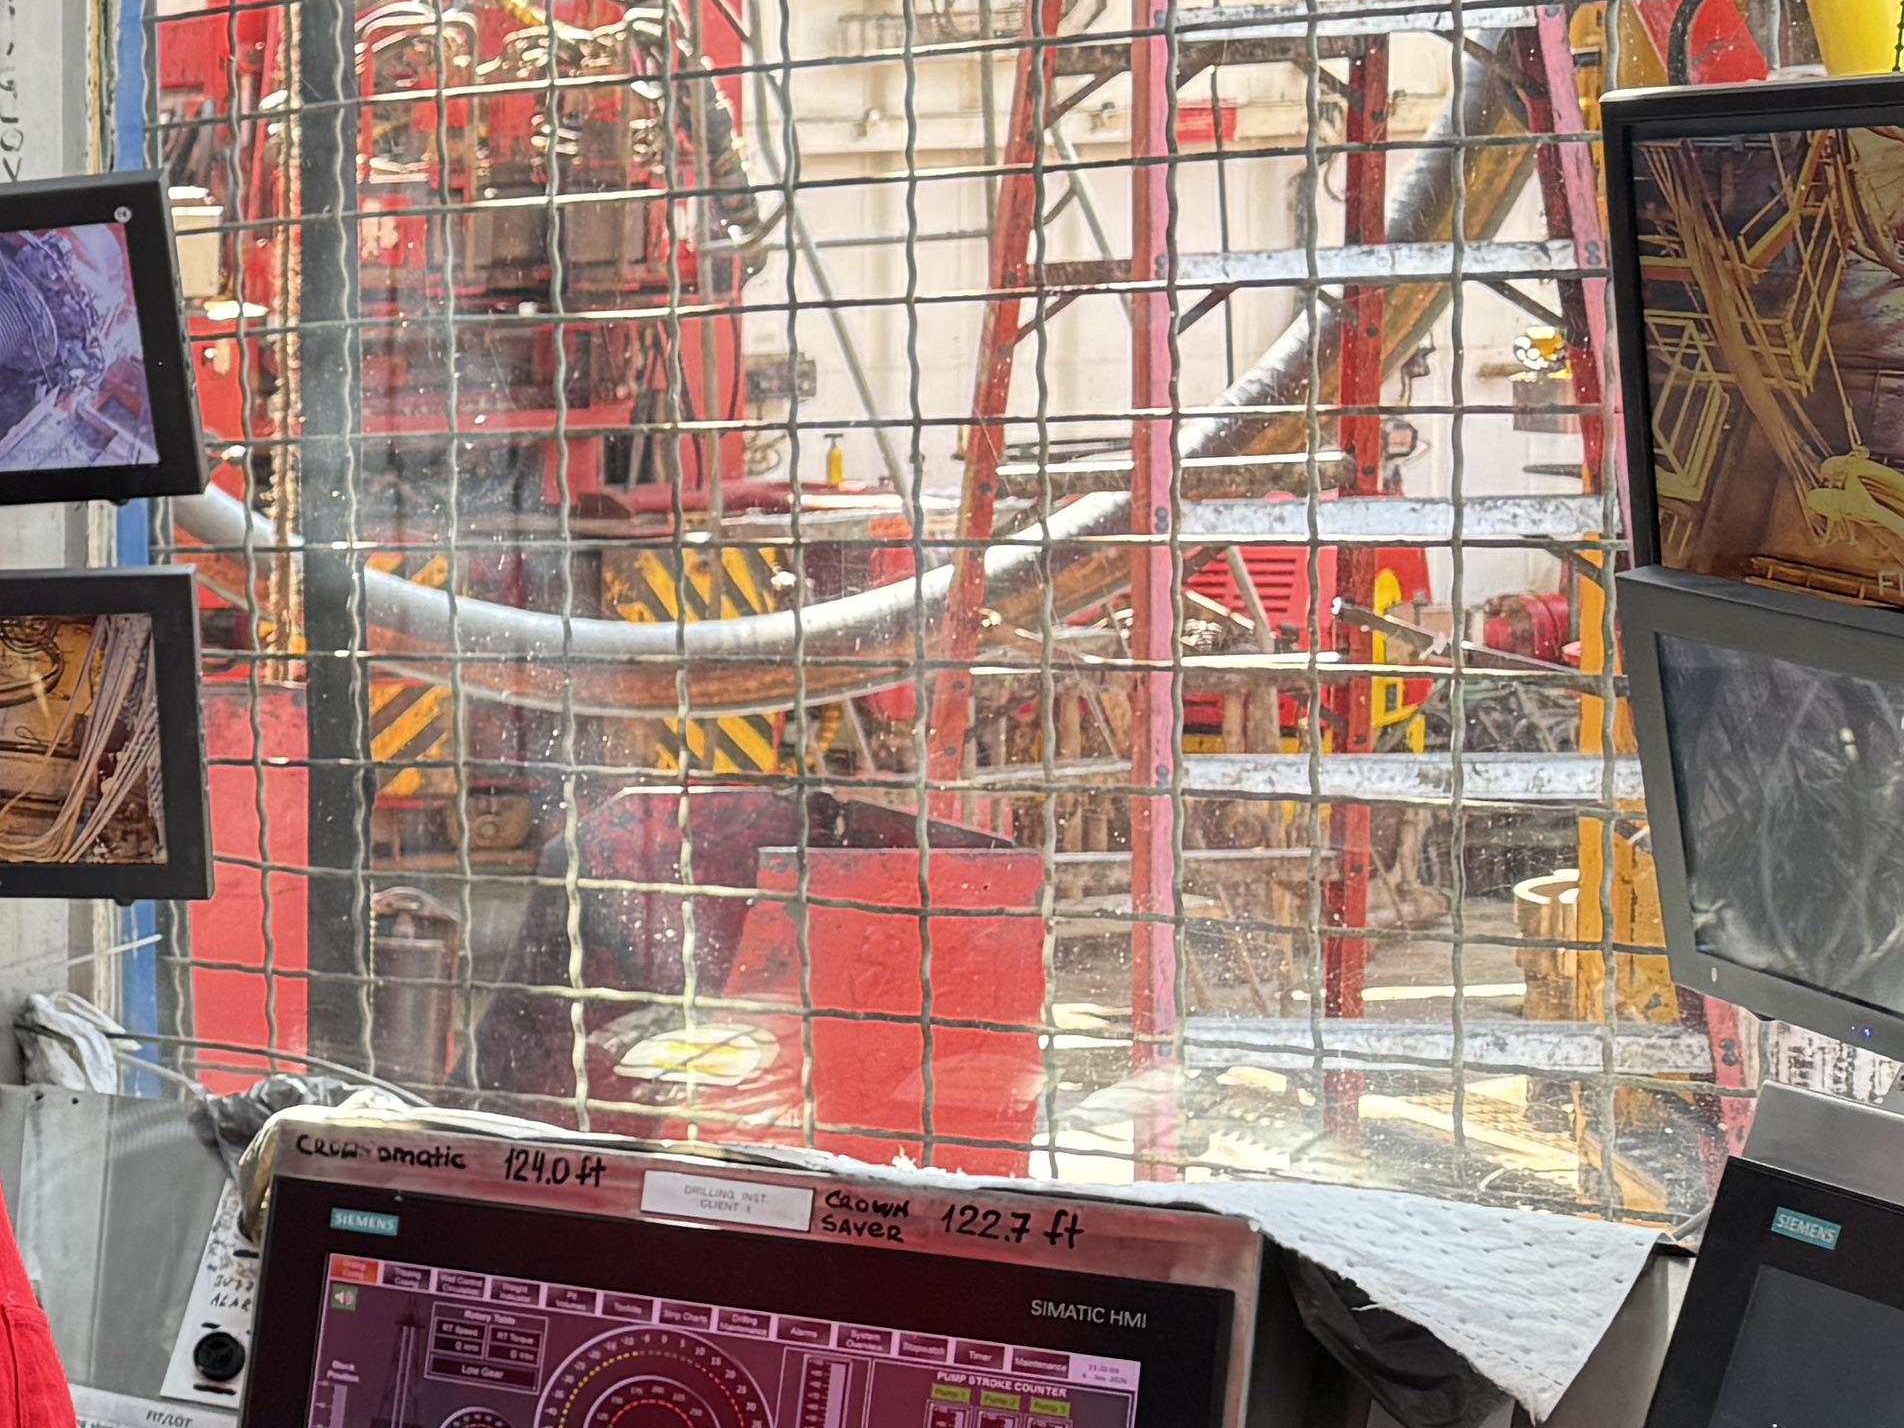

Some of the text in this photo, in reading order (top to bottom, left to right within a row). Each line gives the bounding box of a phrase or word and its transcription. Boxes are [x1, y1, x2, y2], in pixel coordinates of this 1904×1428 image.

[685, 1187, 735, 1202] DRILLING
[700, 1199, 739, 1213] CLIENT
[334, 1213, 395, 1231] SIEMENS
[941, 1203, 1084, 1249] 122.7 ft
[1776, 1211, 1838, 1245] SIEMENS
[1030, 1299, 1147, 1329] SIMATIC HMI
[937, 1372, 1067, 1398] PUMP STROKE COUNTER
[146, 1410, 192, 1428] FIT/LOT
